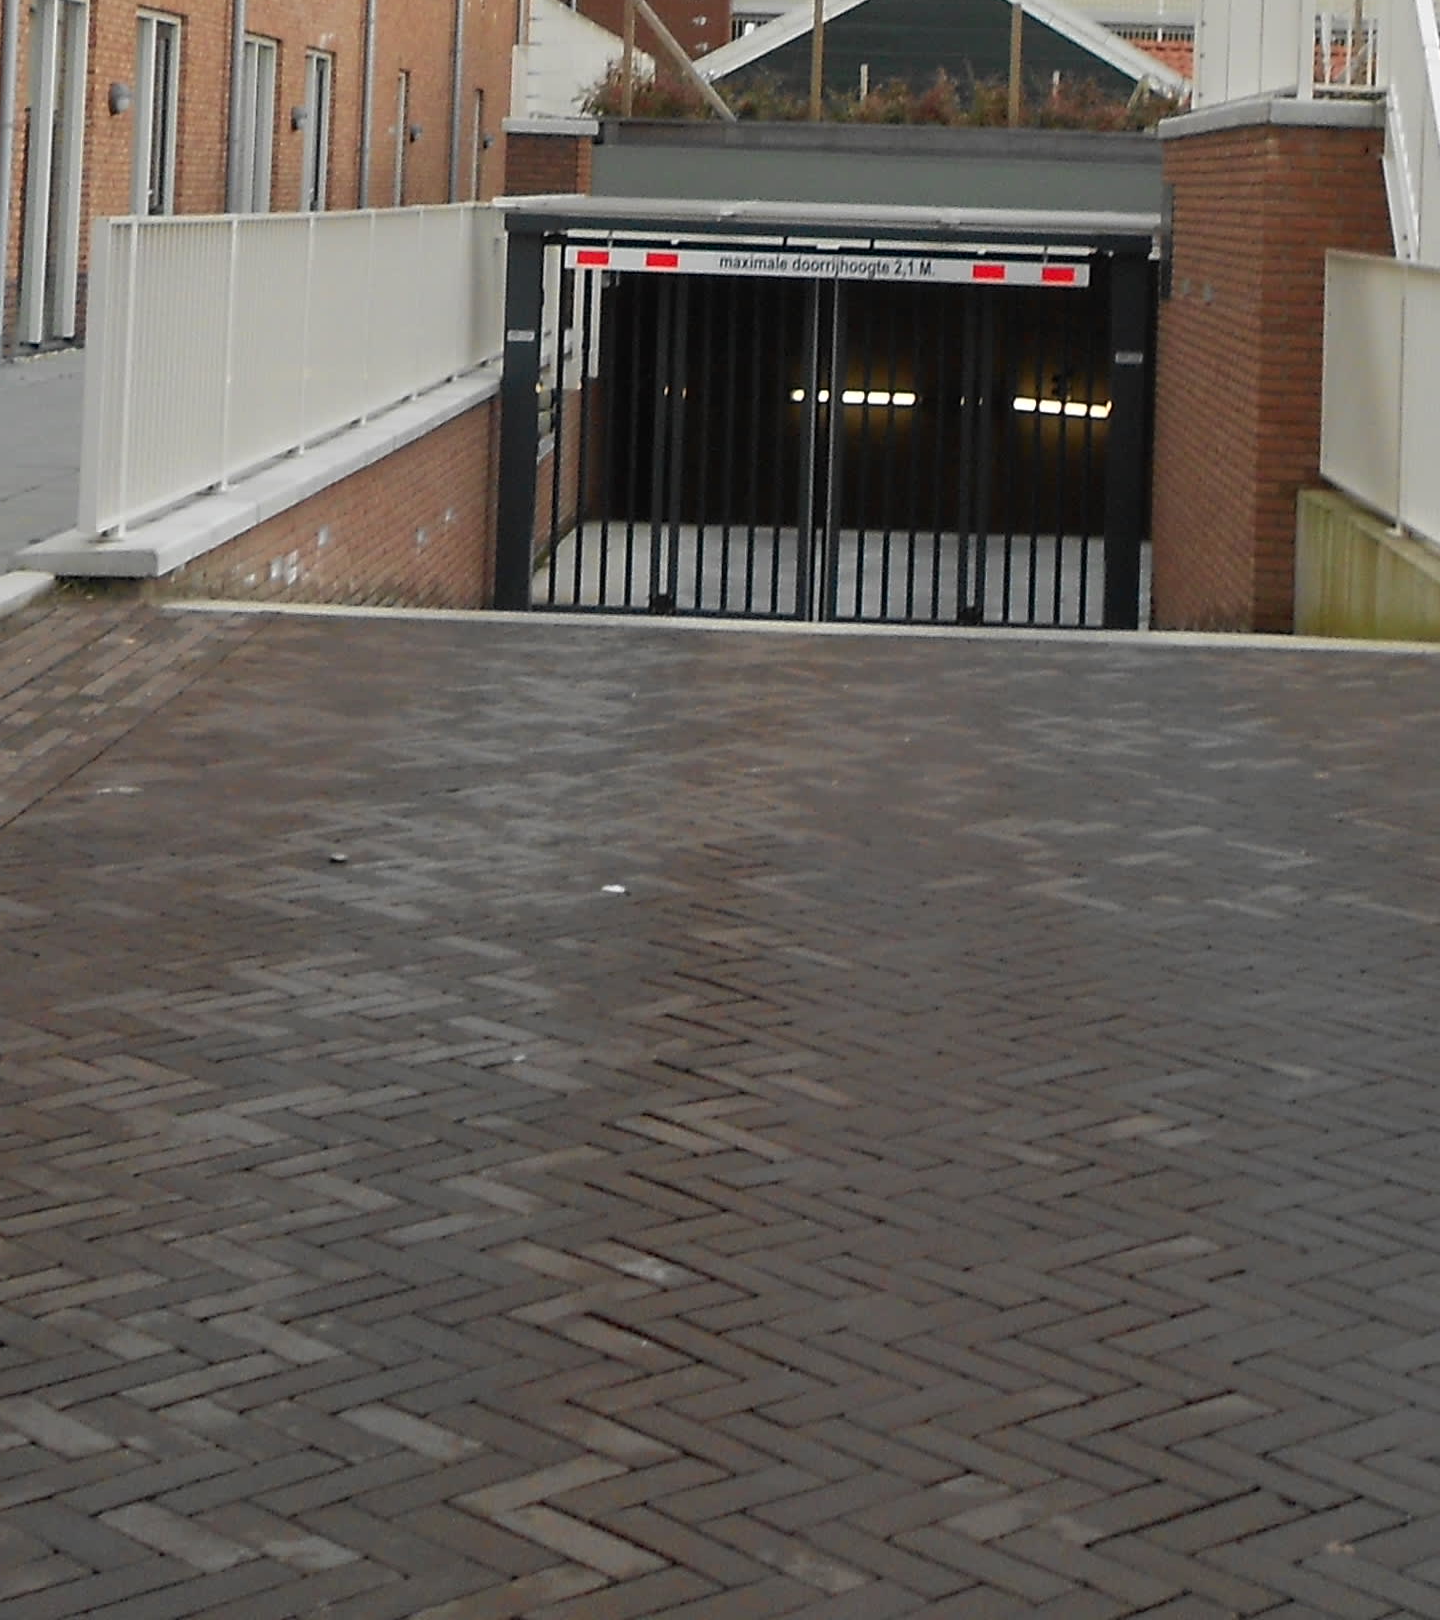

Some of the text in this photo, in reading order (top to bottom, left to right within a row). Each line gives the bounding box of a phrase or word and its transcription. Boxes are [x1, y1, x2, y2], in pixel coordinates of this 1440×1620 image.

[719, 255, 788, 269] maximale
[792, 256, 890, 278] doorrijhoogte
[894, 260, 913, 277] 2,1
